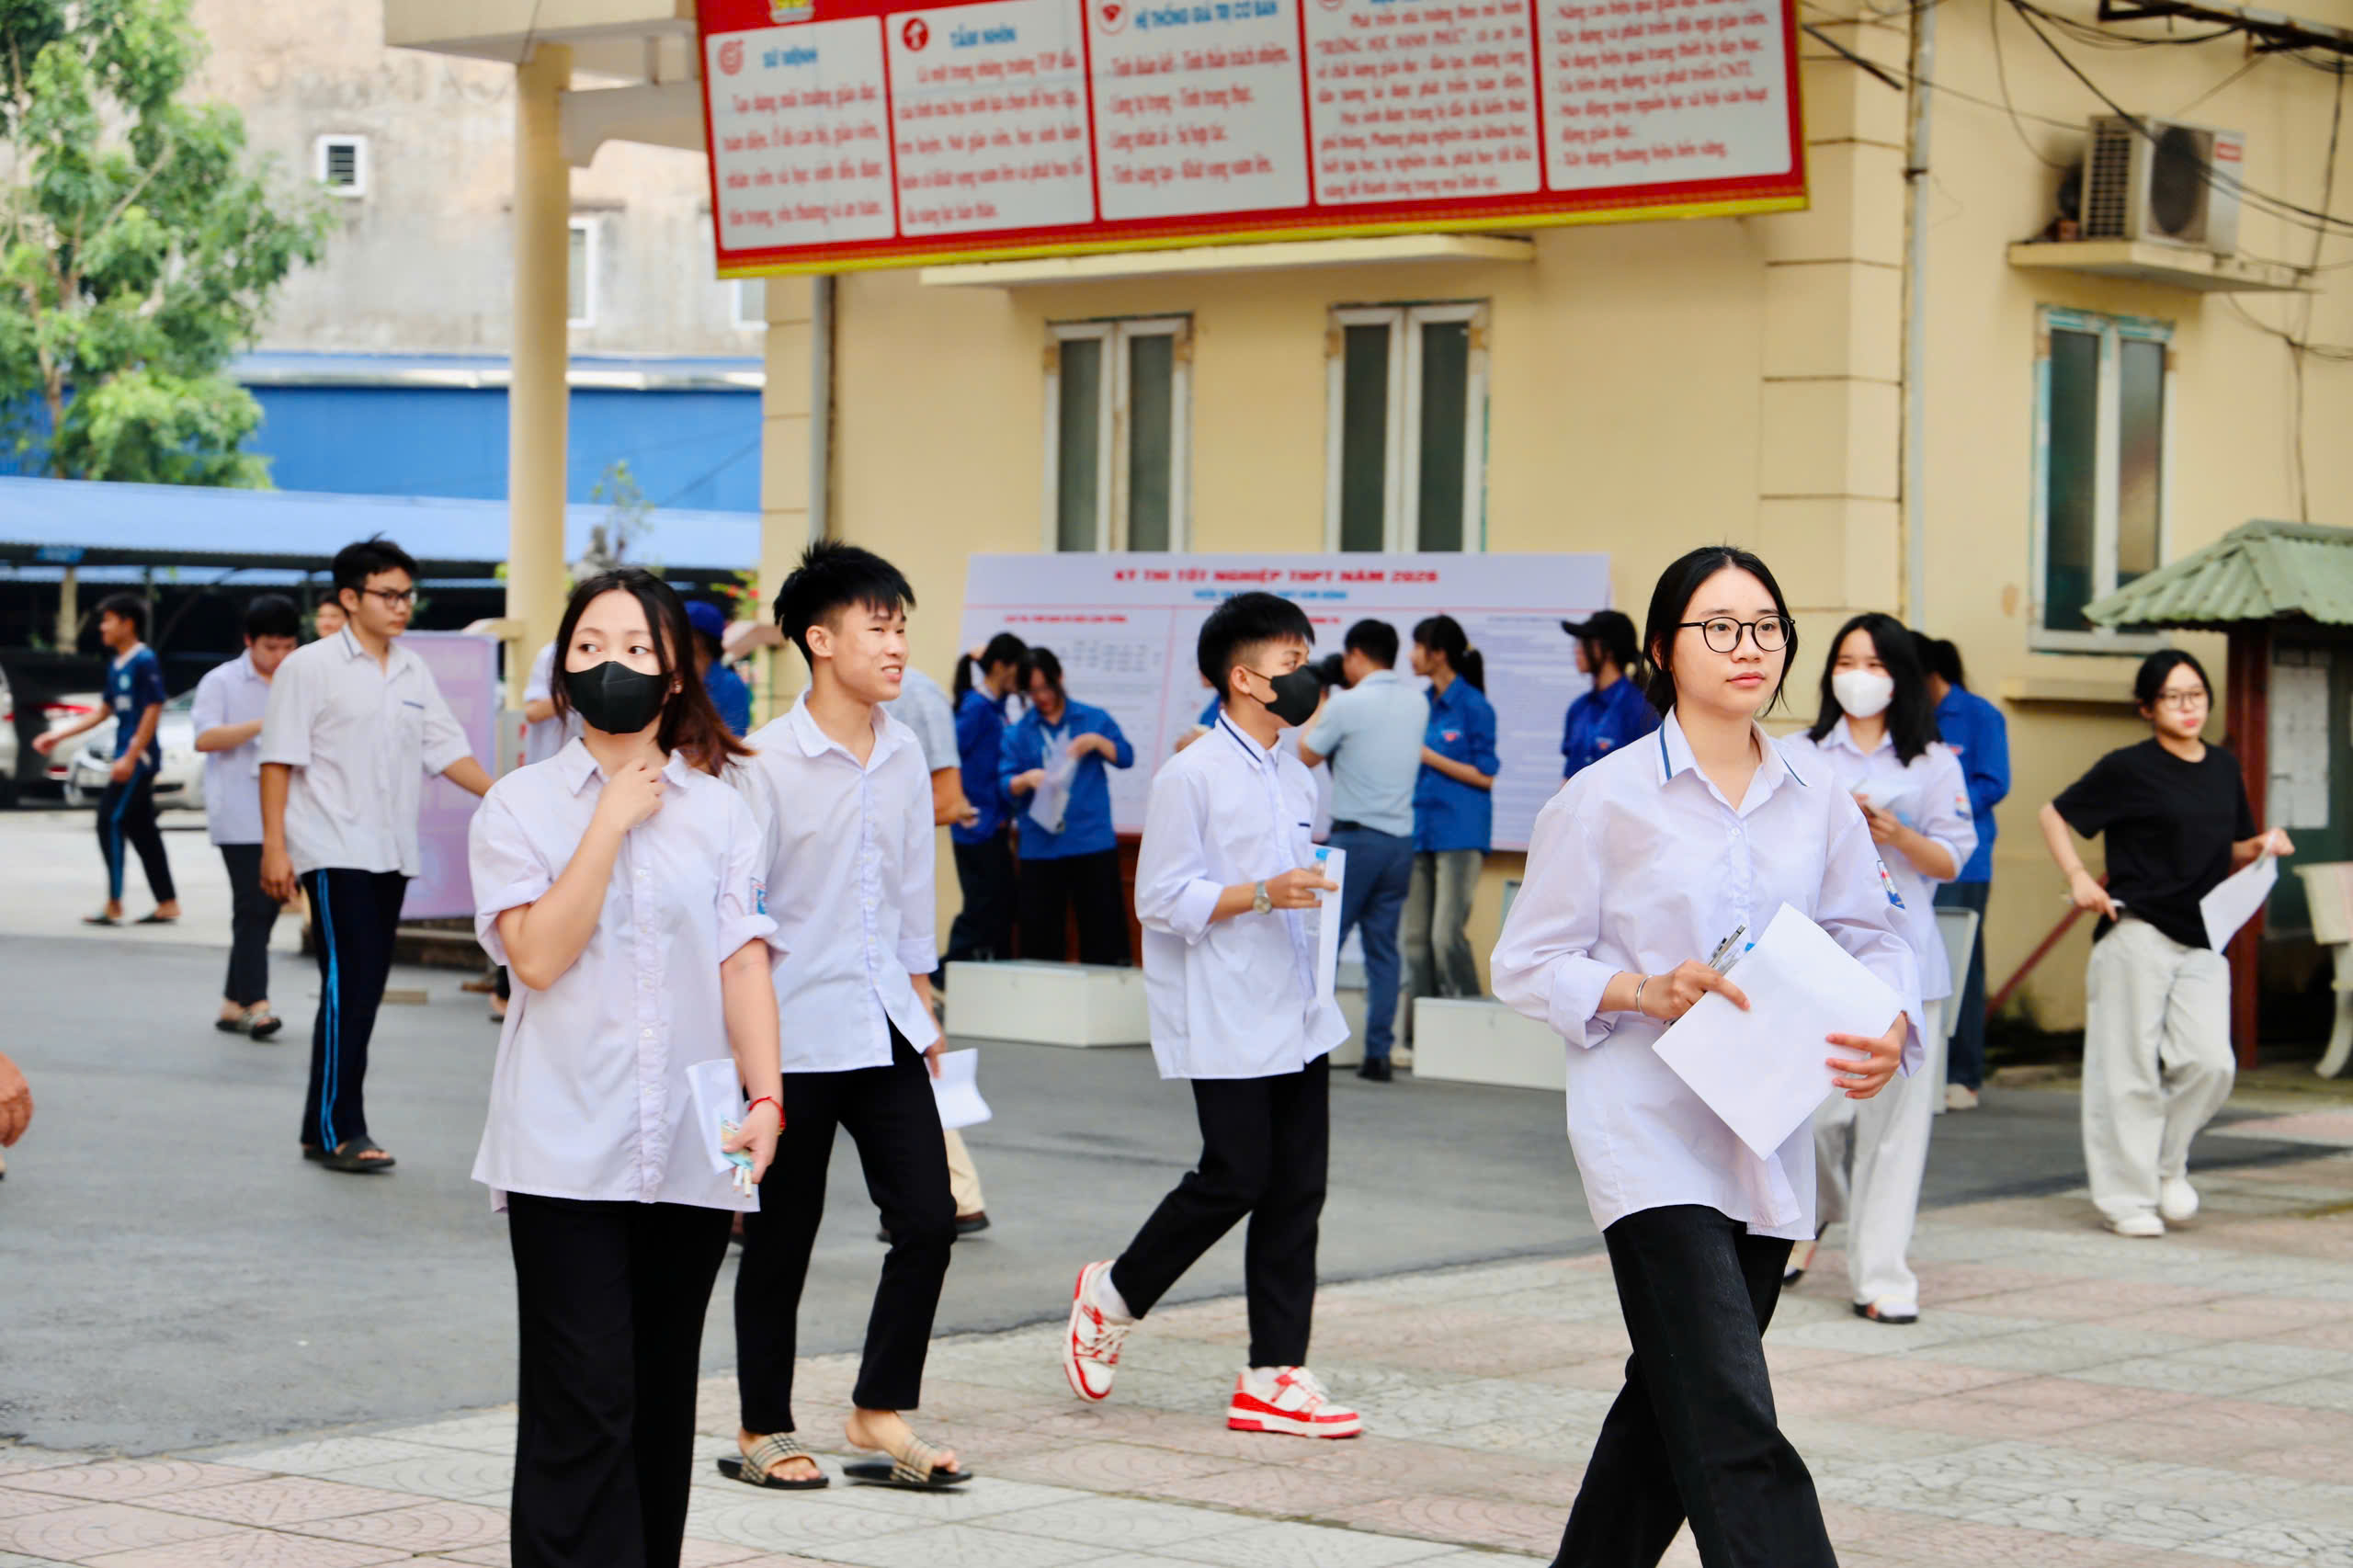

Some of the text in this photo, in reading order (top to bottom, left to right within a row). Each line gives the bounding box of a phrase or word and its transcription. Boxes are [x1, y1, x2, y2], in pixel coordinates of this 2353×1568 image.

[1144, 568, 1170, 582] THI
[1177, 566, 1207, 582] TỐT
[1214, 568, 1280, 585] NGHIỆP
[1289, 569, 1333, 582] THPT
